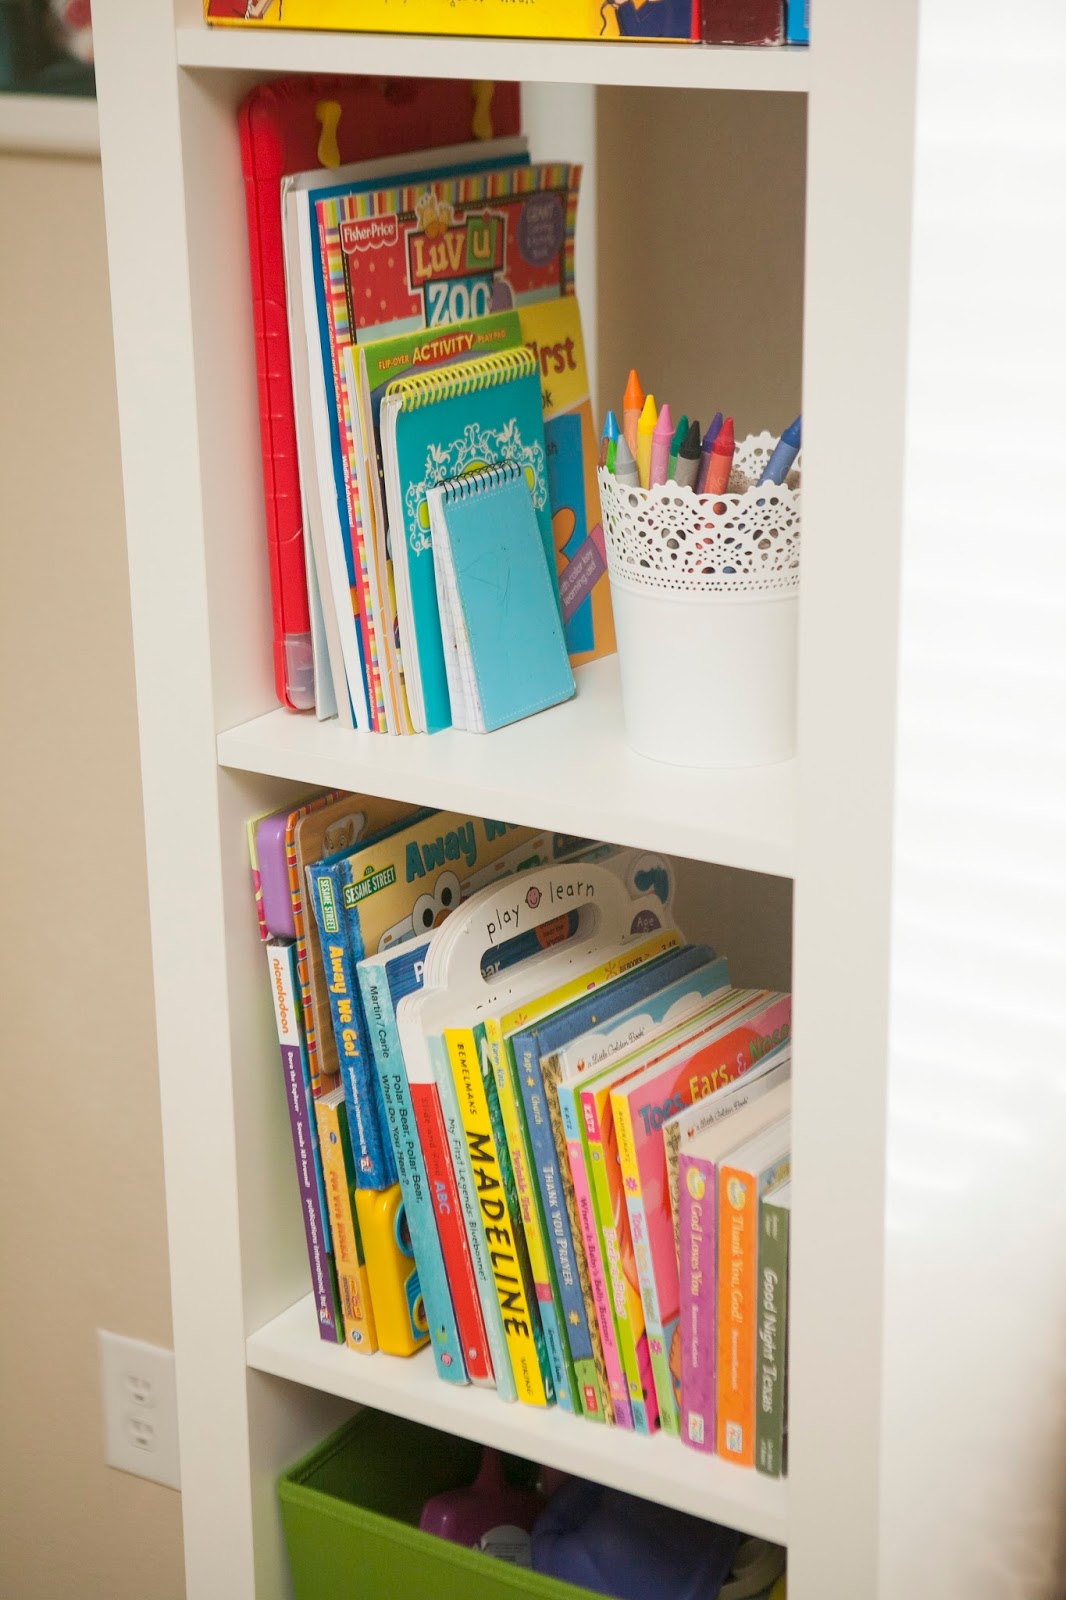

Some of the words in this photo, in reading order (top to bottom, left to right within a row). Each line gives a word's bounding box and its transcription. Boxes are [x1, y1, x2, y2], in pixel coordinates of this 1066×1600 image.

[327, 325, 335, 357] Coloring
[332, 375, 340, 403] Activity
[378, 354, 410, 371] FLIP-OVER
[412, 332, 475, 365] ACTIVITY
[342, 455, 350, 483] Wildlife
[345, 484, 355, 528] Adventures!
[405, 821, 478, 883] Away
[319, 878, 333, 906] SESAME
[344, 878, 373, 905] SESAME
[371, 866, 396, 894] STREET
[323, 906, 337, 932] STREET
[486, 905, 519, 944] play
[548, 881, 595, 903] learn
[327, 945, 348, 994] Away
[272, 957, 289, 1035] nickelodeon
[336, 999, 353, 1023] We
[369, 984, 381, 1021] Martin
[378, 1028, 390, 1059] Carle
[341, 1029, 360, 1057] Go!
[381, 1074, 392, 1104] What
[457, 1043, 478, 1116] BEMELMANS
[522, 1051, 533, 1074] Page
[530, 1095, 544, 1126] Church
[639, 1092, 690, 1137] Toes,
[688, 1063, 735, 1104] Ears,
[388, 1107, 396, 1124] Do
[563, 1106, 573, 1130] KATZ
[583, 1103, 597, 1134] KATZ
[391, 1127, 400, 1149] You
[392, 1074, 404, 1105] Polar
[399, 1108, 410, 1138] Bear,
[405, 1141, 417, 1171] Polar
[412, 1174, 423, 1204] Bear,
[397, 1151, 410, 1186] Hear?
[512, 1150, 527, 1195] Twinkle
[520, 1198, 532, 1223] Toes
[434, 1181, 452, 1216] ABC
[448, 1118, 456, 1137] My
[452, 1138, 465, 1168] First
[469, 1221, 488, 1282] Bluebonnet
[691, 1202, 704, 1232] God
[305, 1198, 318, 1244] publications
[313, 1245, 326, 1295] international,
[466, 1131, 530, 1339] MADELINE
[542, 1165, 559, 1208] THANK
[551, 1211, 565, 1238] YOU
[558, 1236, 574, 1287] PRAYER
[730, 1216, 743, 1256] Thank
[580, 1197, 593, 1235] Where
[587, 1244, 599, 1278] Baby's
[593, 1279, 605, 1305] Belly
[690, 1232, 703, 1270] Loves
[690, 1270, 703, 1297] You
[763, 1267, 778, 1313] Good
[731, 1291, 743, 1324] God!
[759, 1314, 777, 1361] Night
[520, 1357, 534, 1396] VIKING
[762, 1364, 777, 1414] Texas
